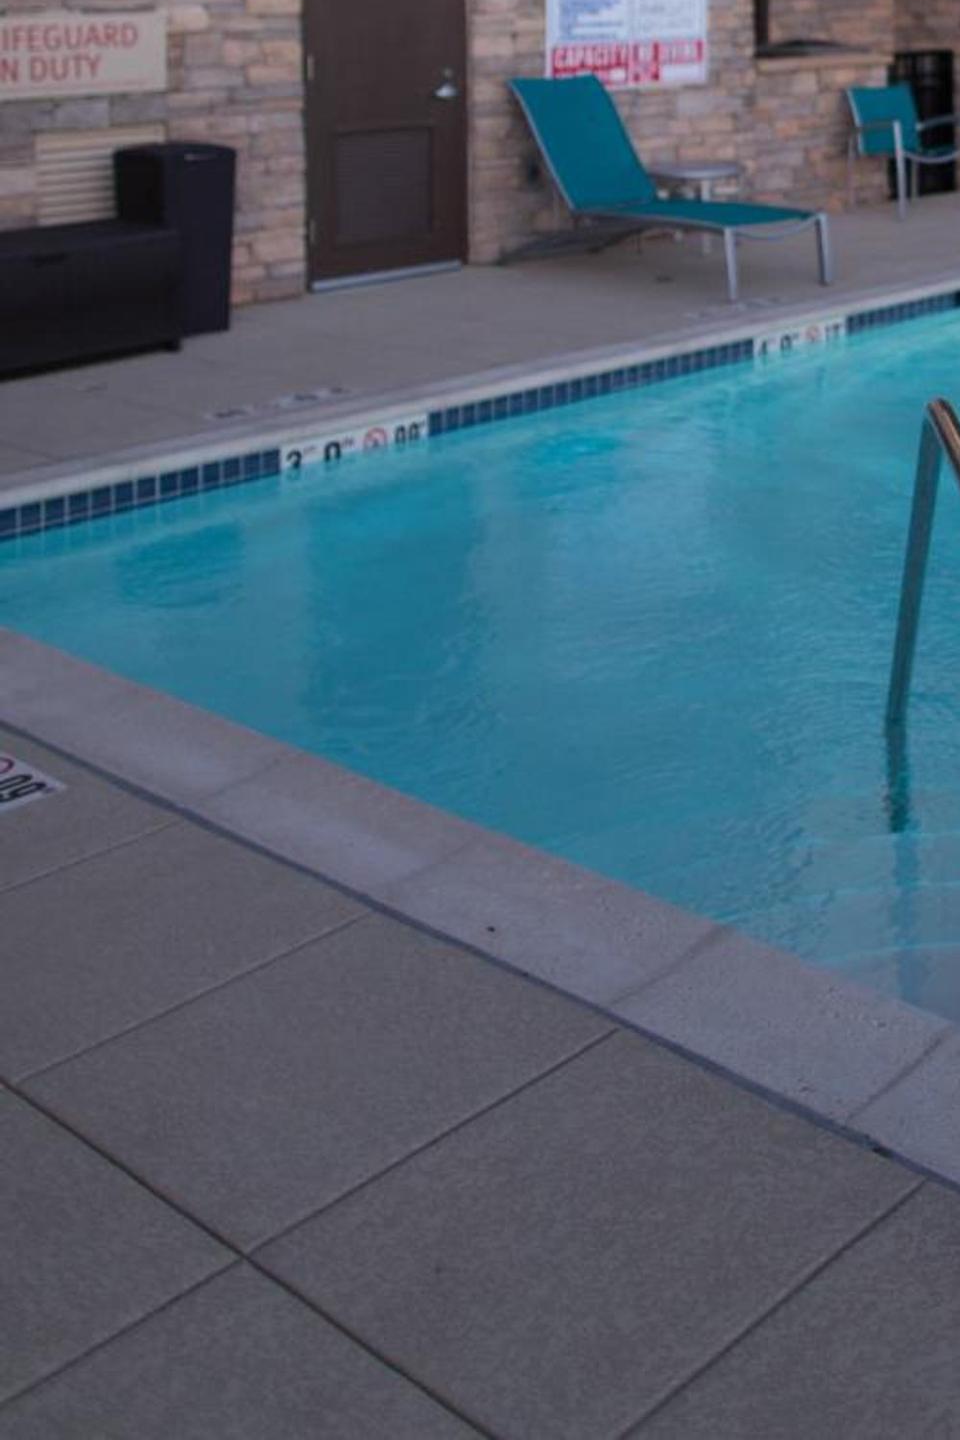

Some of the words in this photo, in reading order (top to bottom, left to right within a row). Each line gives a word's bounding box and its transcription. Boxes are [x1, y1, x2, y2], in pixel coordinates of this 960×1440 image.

[1, 23, 139, 51] IFEGUARD
[0, 58, 19, 82] N
[30, 54, 101, 82] DUTY
